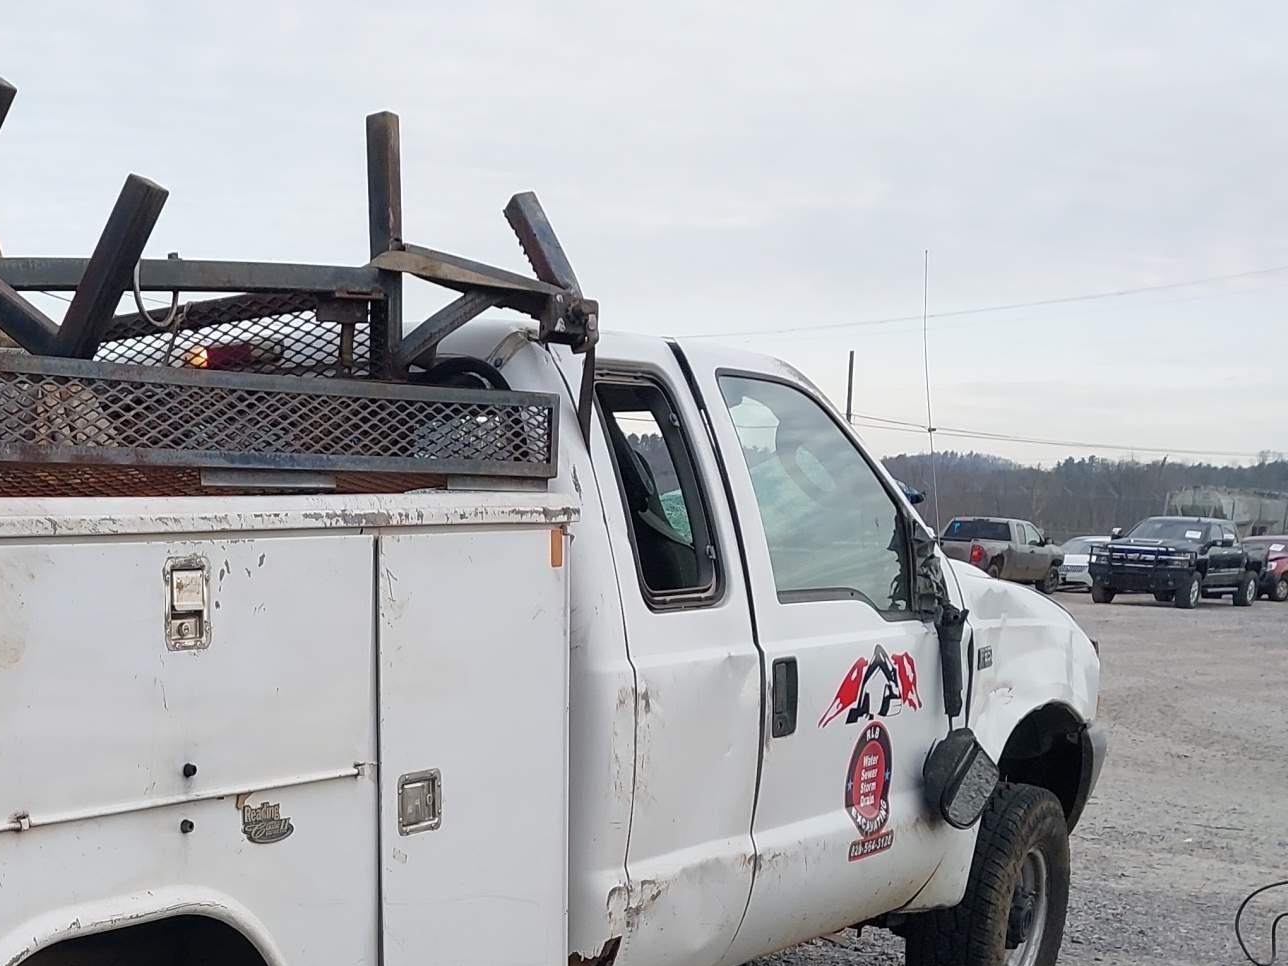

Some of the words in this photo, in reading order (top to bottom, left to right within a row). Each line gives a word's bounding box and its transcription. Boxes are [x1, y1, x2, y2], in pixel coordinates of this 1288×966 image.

[866, 727, 880, 741] RLB
[863, 754, 879, 767] Water
[861, 768, 878, 781] Sewer
[860, 782, 876, 794] Storm
[245, 803, 280, 822] Reading
[851, 799, 887, 833] EXCAVATING
